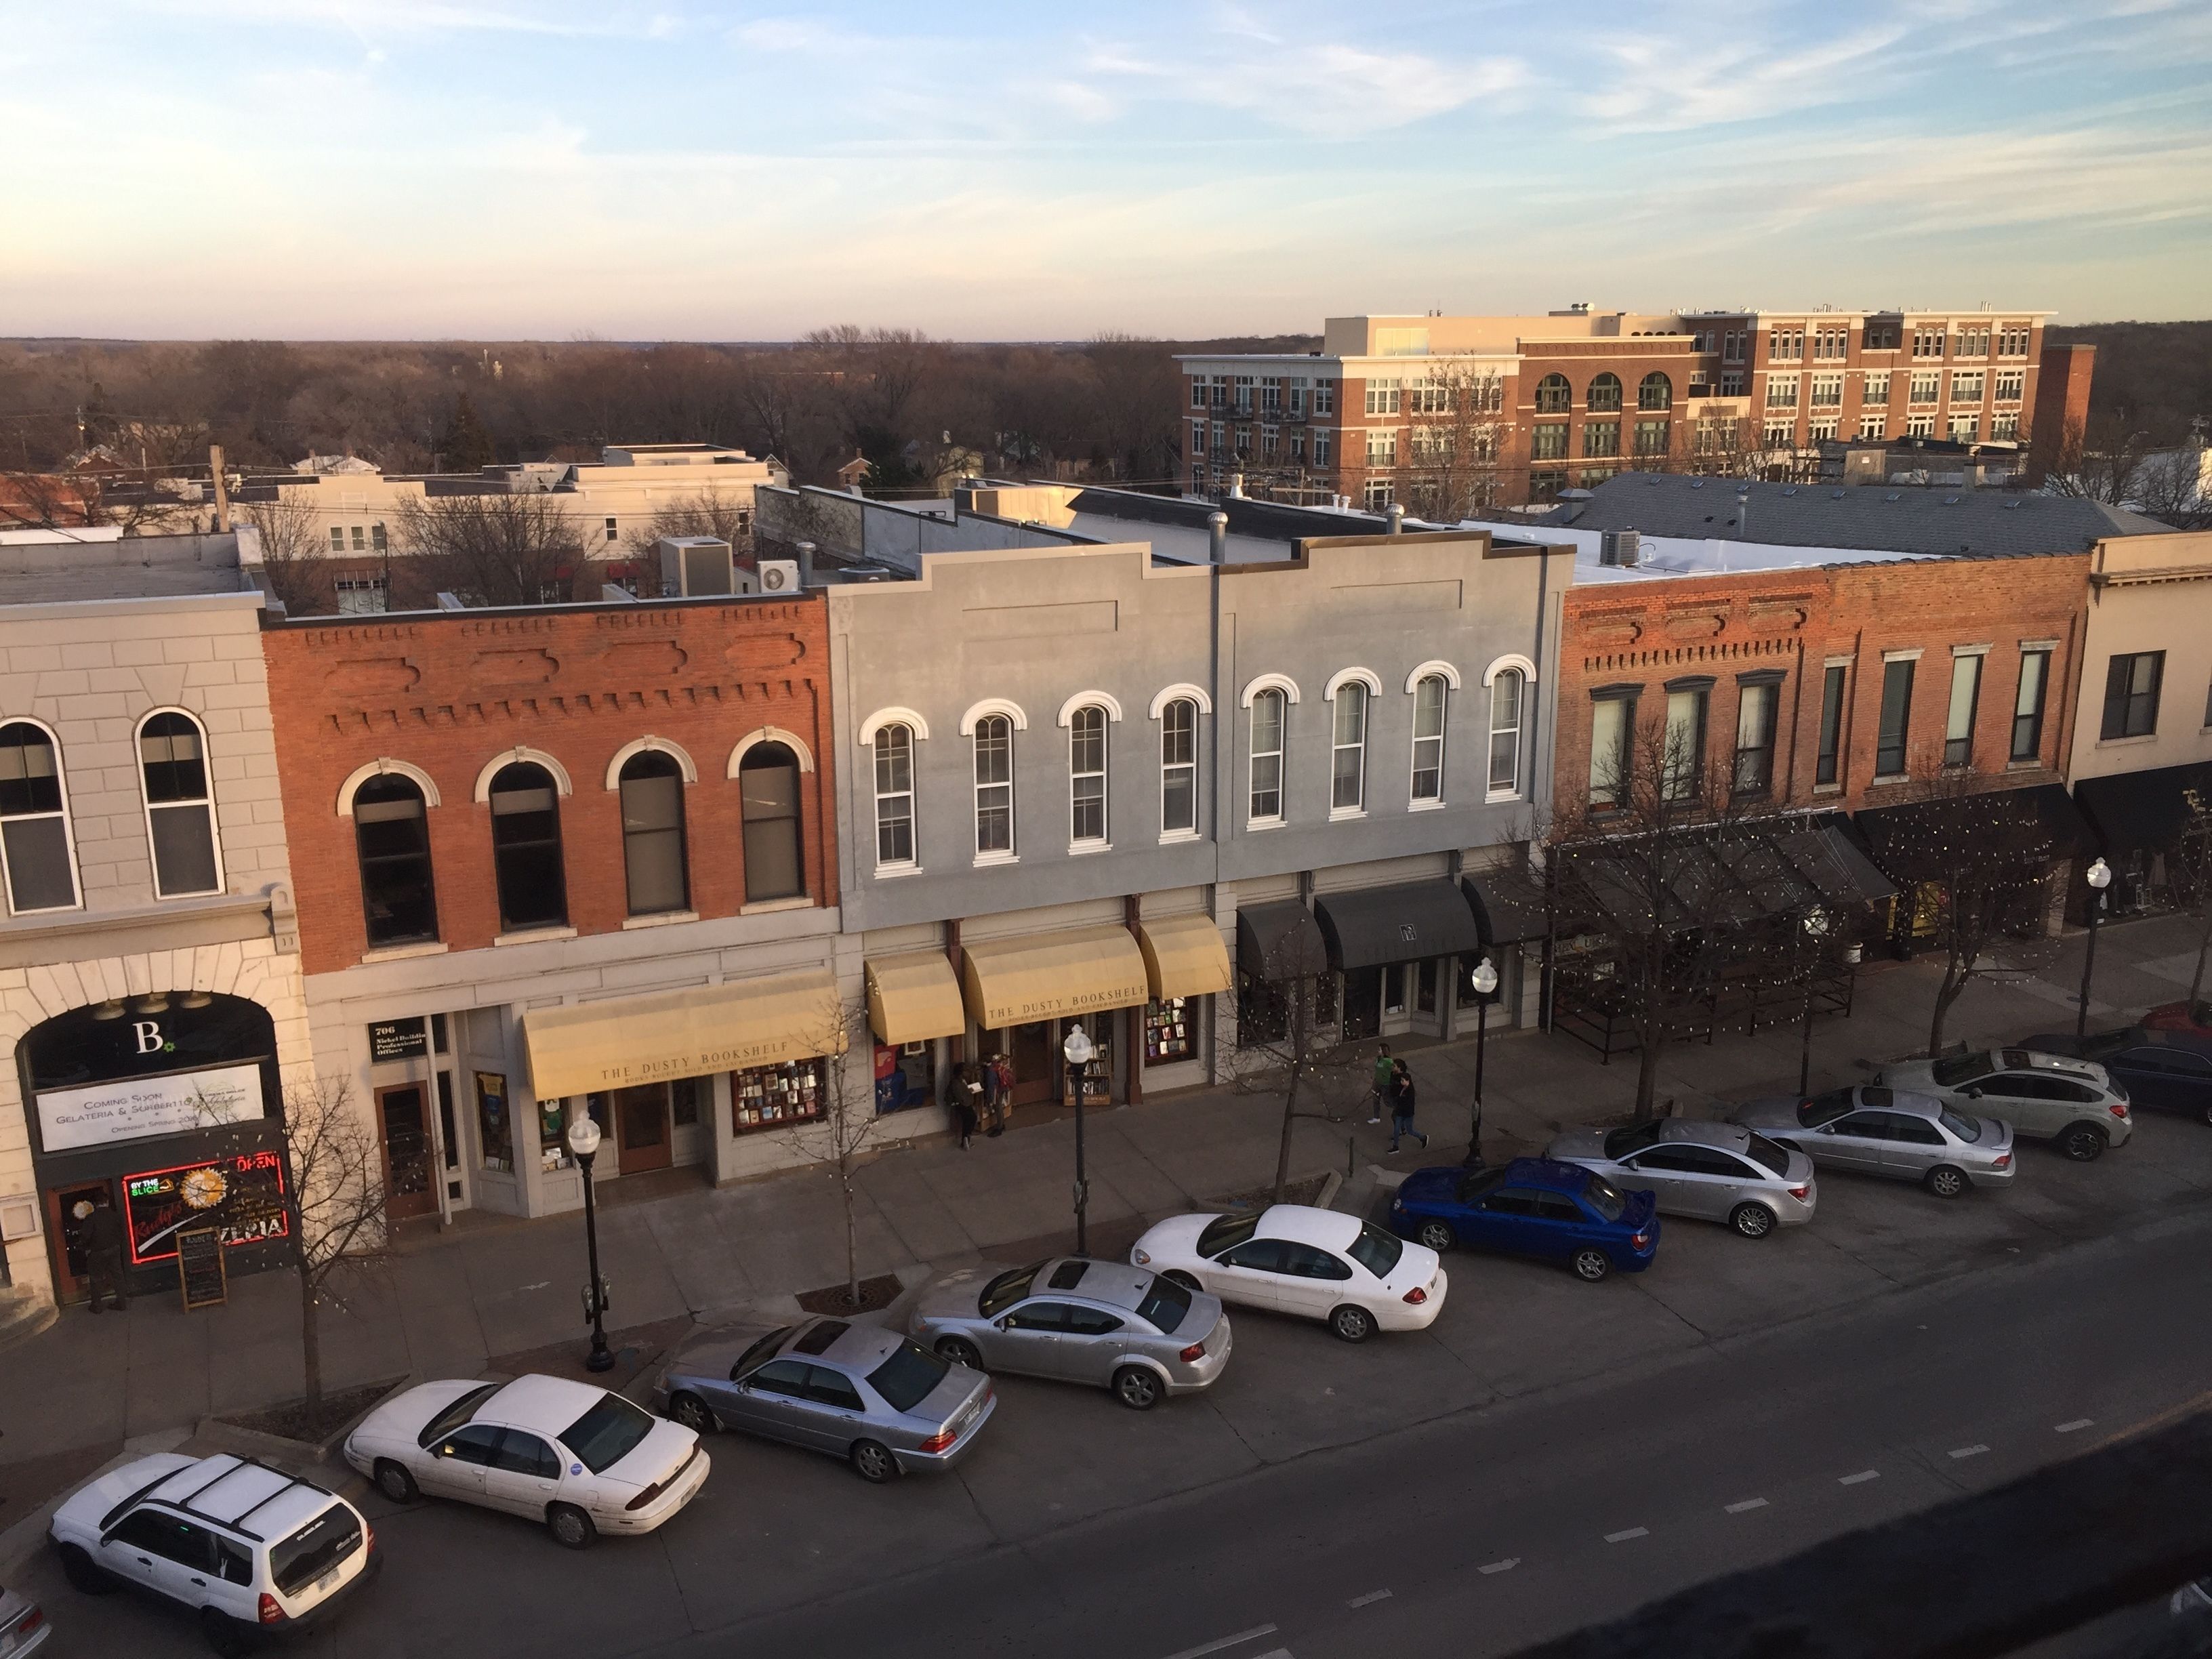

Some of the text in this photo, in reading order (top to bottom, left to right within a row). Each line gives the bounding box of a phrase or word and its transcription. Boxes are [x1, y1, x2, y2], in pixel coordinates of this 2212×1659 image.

[989, 985, 1145, 1019] THE DUSTY BOOKSHELF
[375, 1026, 396, 1036] 706
[132, 1021, 163, 1054] B
[376, 1033, 426, 1044] Nickel Buildin
[377, 1039, 422, 1050] Professional
[377, 1048, 403, 1056] Offices
[602, 1042, 787, 1080] THE DUSTY BOOKSHELF
[119, 1107, 127, 1115] &
[237, 1155, 275, 1172] OPEN
[130, 1179, 159, 1190] BY THE
[131, 1186, 159, 1197] SLICE
